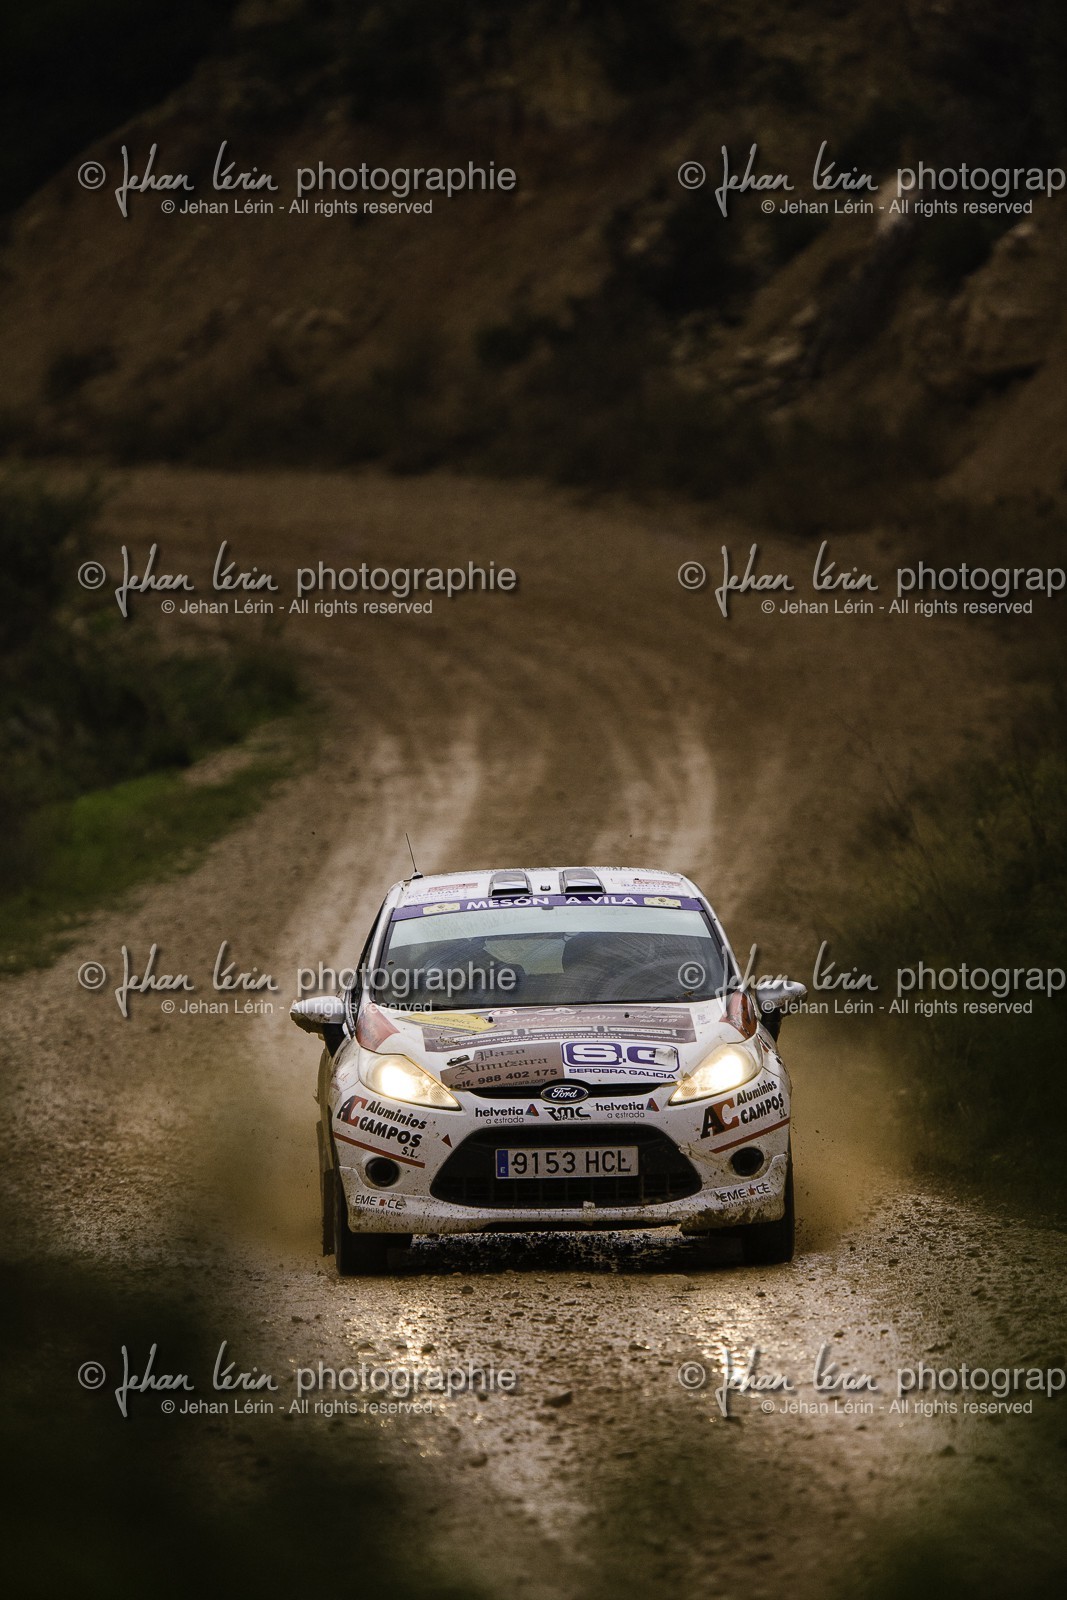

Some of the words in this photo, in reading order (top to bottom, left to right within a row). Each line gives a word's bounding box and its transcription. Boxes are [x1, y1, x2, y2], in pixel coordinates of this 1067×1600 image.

[466, 895, 550, 911] MESÓN
[566, 896, 582, 905] A
[587, 895, 638, 906] VILA
[477, 1073, 502, 1085] 988
[505, 1070, 530, 1080] 402
[533, 1068, 558, 1077] 175
[568, 1067, 628, 1075] SEROBRA
[628, 1069, 677, 1080] GALICIA
[551, 1087, 578, 1099] Ford
[736, 1079, 778, 1107] Aluminios
[366, 1100, 429, 1130] Aluminios
[475, 1106, 524, 1118] helvetia
[595, 1102, 645, 1112] helvetia
[614, 1110, 646, 1119] estrada
[740, 1092, 785, 1125] CAMPOS
[493, 1115, 525, 1125] estrada
[358, 1116, 424, 1148] CAMPOS
[499, 1166, 506, 1174] E
[513, 1152, 577, 1174] 9153
[586, 1151, 631, 1173] HCL
